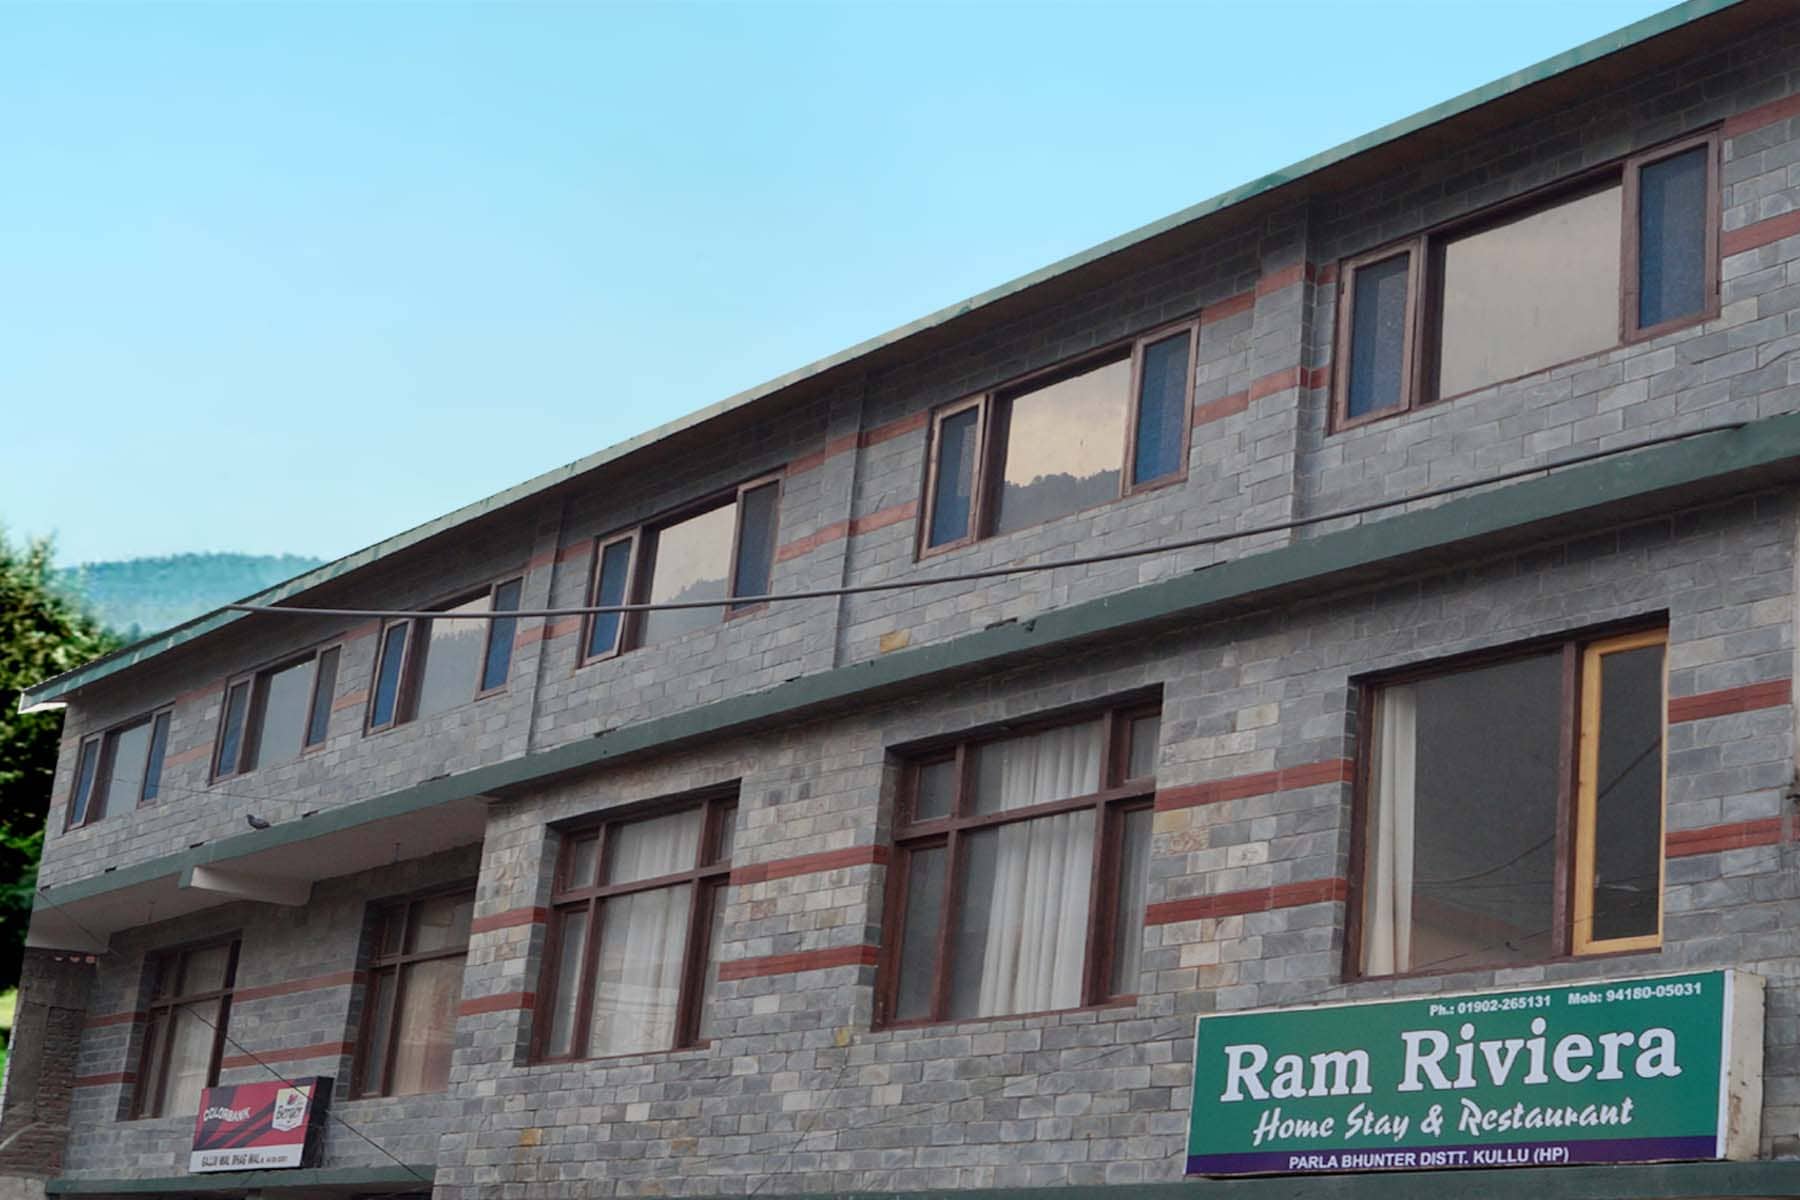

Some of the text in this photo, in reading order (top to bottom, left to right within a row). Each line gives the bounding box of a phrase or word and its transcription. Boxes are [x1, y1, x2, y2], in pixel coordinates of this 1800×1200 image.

[1457, 995, 1551, 1014] 01902-265131
[1568, 991, 1602, 1005] Mob:
[1606, 982, 1702, 1002] 94180-05031
[1220, 1017, 1682, 1102] Ram Riviera
[1253, 1096, 1634, 1147] Home Stay & Restaurant
[1289, 1147, 1569, 1169] PARLA BHUNTER DISTT. KULLU (HP)
